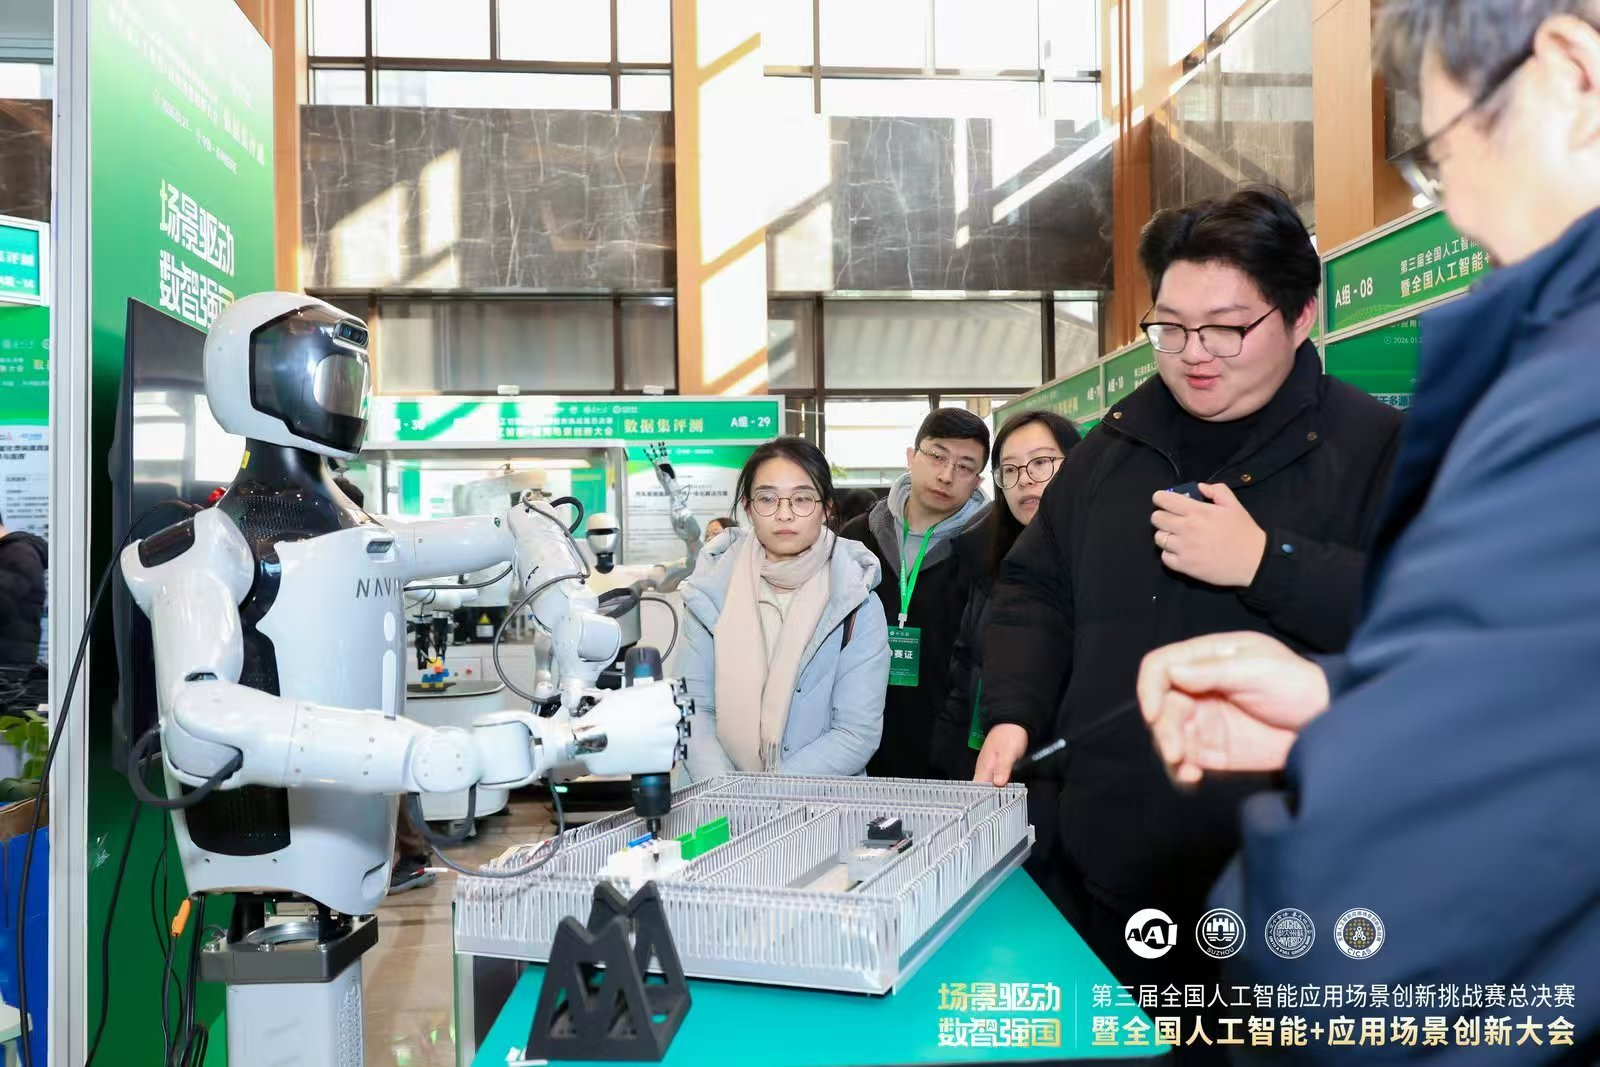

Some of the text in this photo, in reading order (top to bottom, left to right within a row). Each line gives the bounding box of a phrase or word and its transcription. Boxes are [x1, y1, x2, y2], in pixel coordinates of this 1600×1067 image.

[159, 178, 235, 278] 场景驱动
[624, 418, 704, 433] 数据集评测
